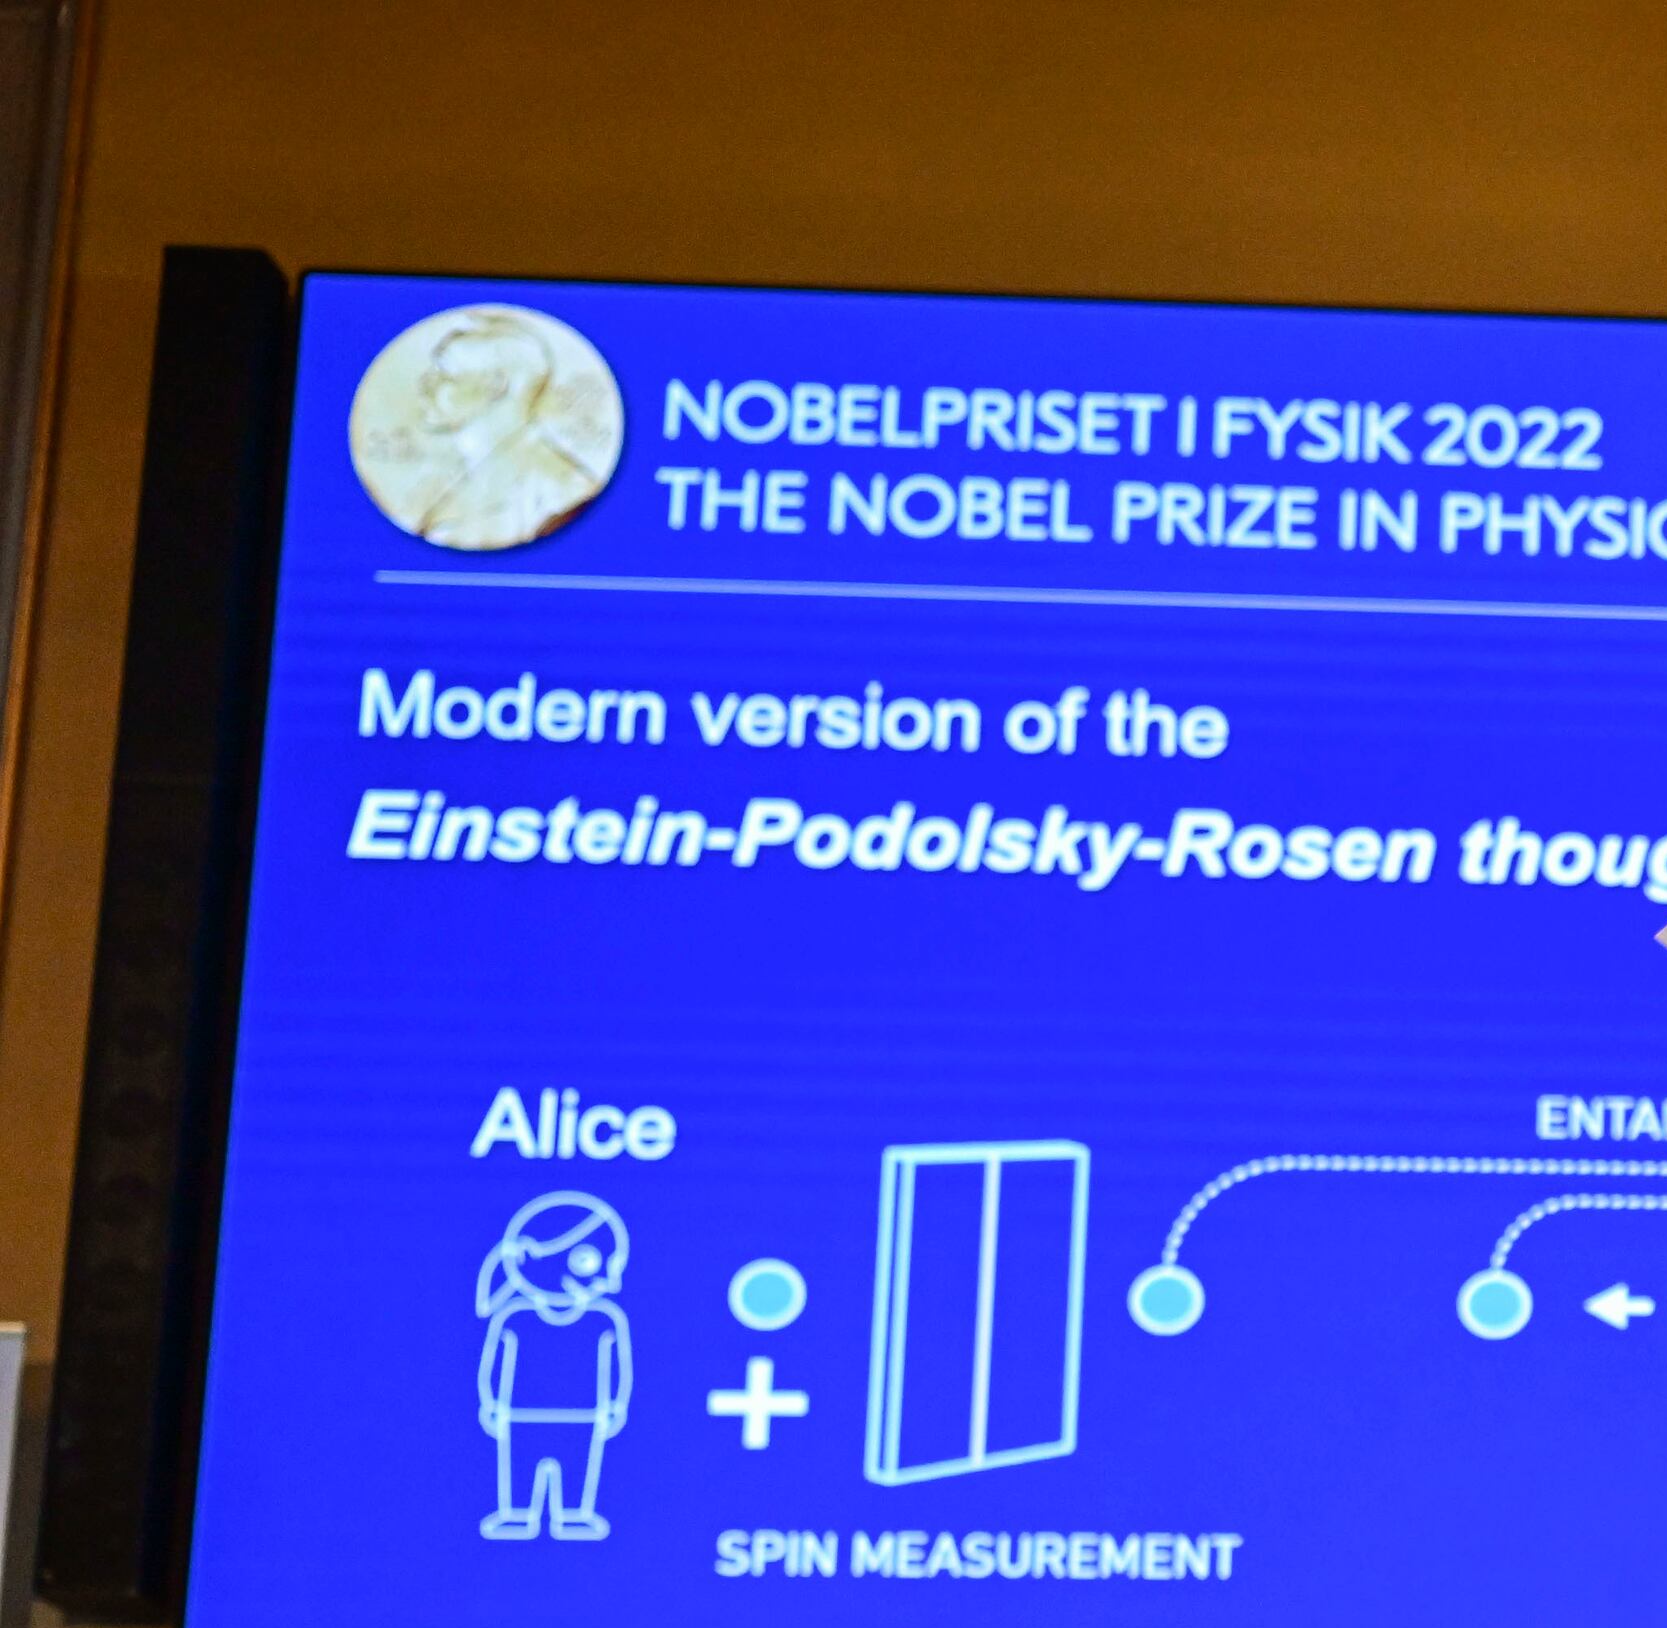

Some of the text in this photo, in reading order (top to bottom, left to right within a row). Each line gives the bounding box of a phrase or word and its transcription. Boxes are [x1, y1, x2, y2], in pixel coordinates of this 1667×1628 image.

[661, 377, 1169, 457] NOBELPRISET
[1175, 394, 1199, 459] I
[1210, 395, 1413, 466] FYSIK
[1420, 401, 1605, 472] 2022
[653, 465, 810, 535] THE
[826, 471, 1095, 544] NOBEL
[1110, 479, 1320, 551] PRIZE
[1337, 487, 1420, 554] IN
[357, 666, 1231, 760] Modern version of the
[345, 787, 1439, 893] Einstein-Podolsky-Rosen
[468, 1085, 678, 1162] Alice
[713, 1527, 1245, 1582] SPIN MEASUREMENT
